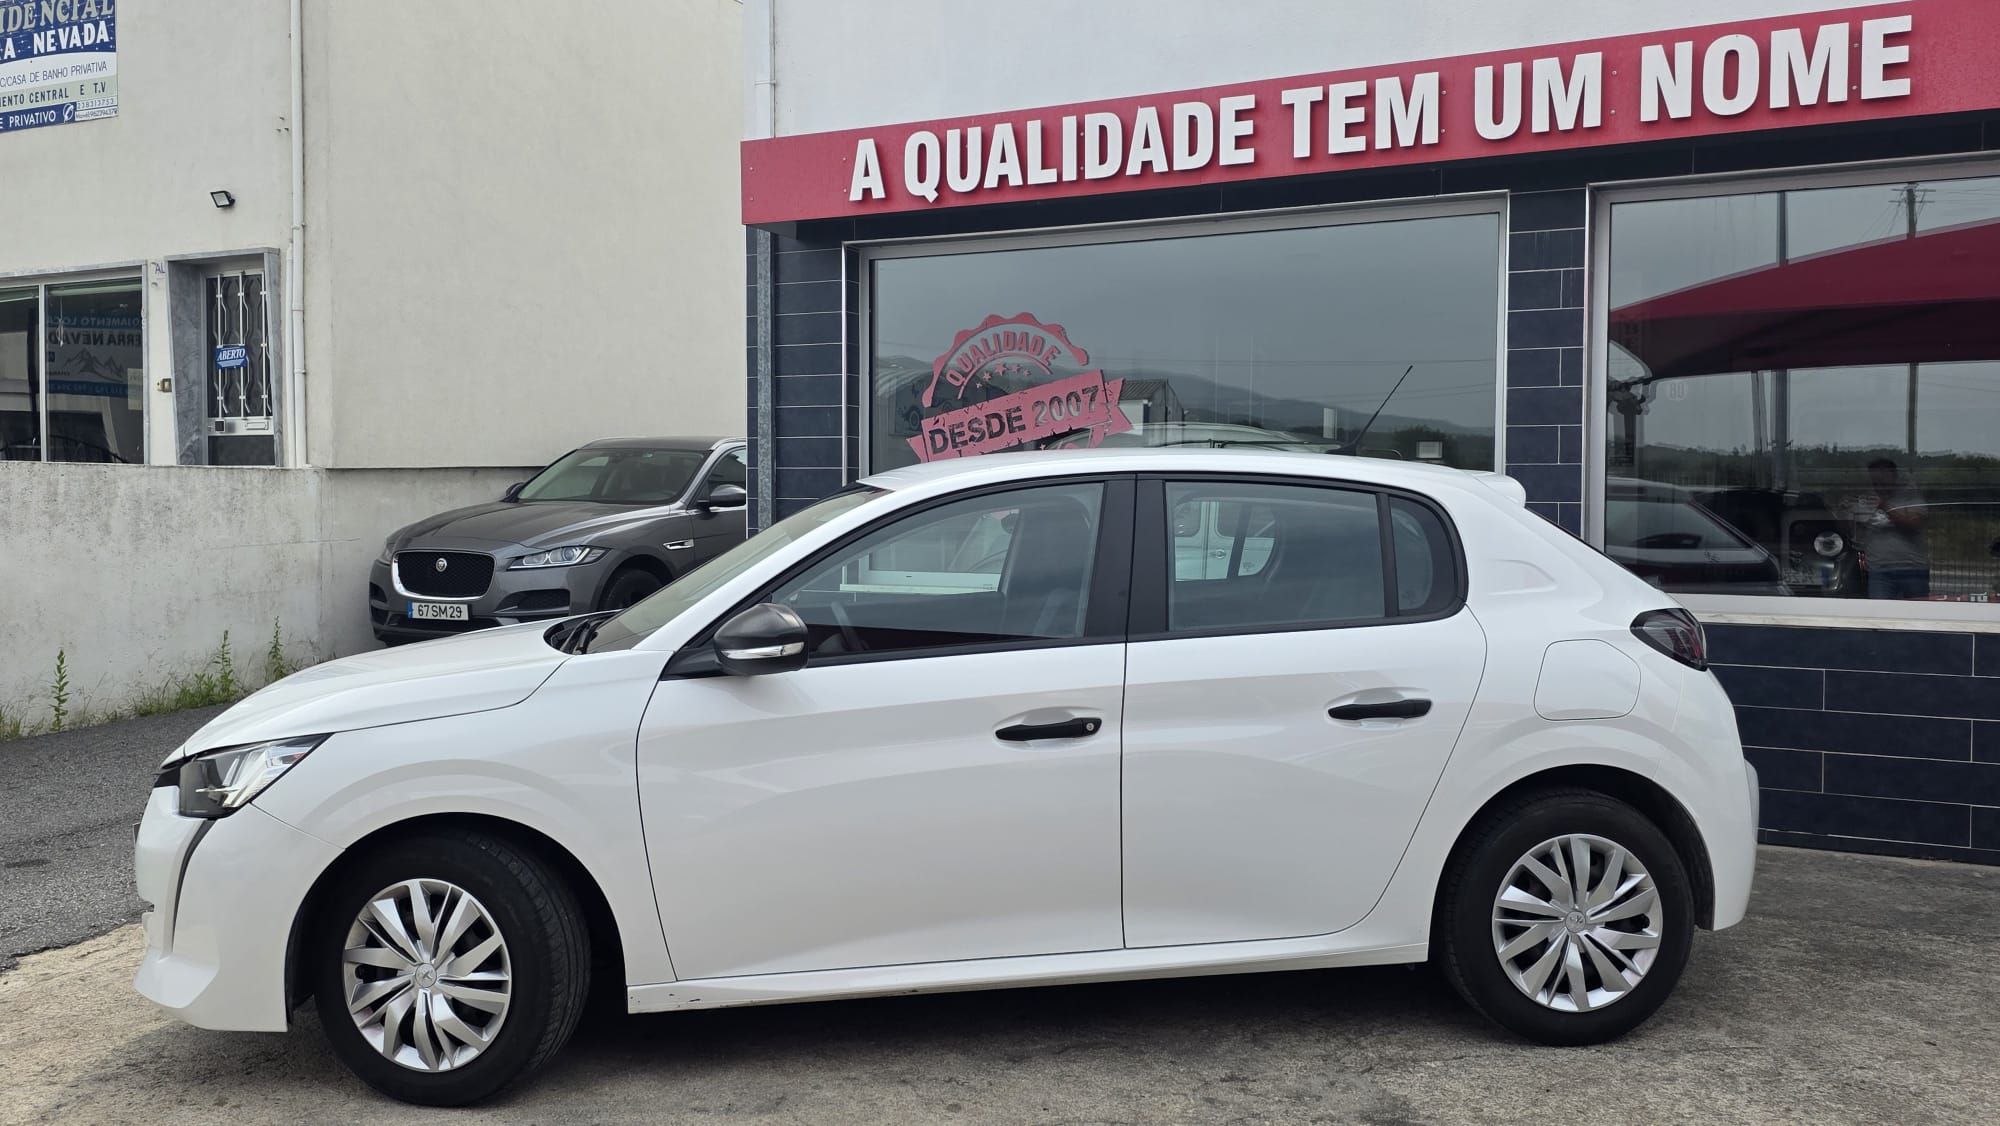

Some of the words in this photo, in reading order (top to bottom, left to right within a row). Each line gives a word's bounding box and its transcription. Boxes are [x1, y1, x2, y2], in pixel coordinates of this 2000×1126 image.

[33, 21, 109, 55] NEVADA
[29, 71, 40, 83] DE
[42, 66, 68, 81] BANHO
[70, 61, 107, 75] PRIVATIVA
[0, 93, 25, 107] ENTO
[29, 88, 69, 103] CENTRAL
[80, 84, 85, 95] E
[849, 138, 886, 201] A
[904, 95, 1255, 203] QUALIDADE
[1281, 72, 1439, 158] TEM
[1474, 51, 1602, 140] UM
[1640, 15, 1912, 122] NOME
[9, 110, 57, 128] PRIVATIVO
[217, 348, 246, 361] ABERTO
[946, 330, 1060, 386] QUALIDADE
[929, 406, 1026, 455] DESDE
[1032, 385, 1100, 427] 2007
